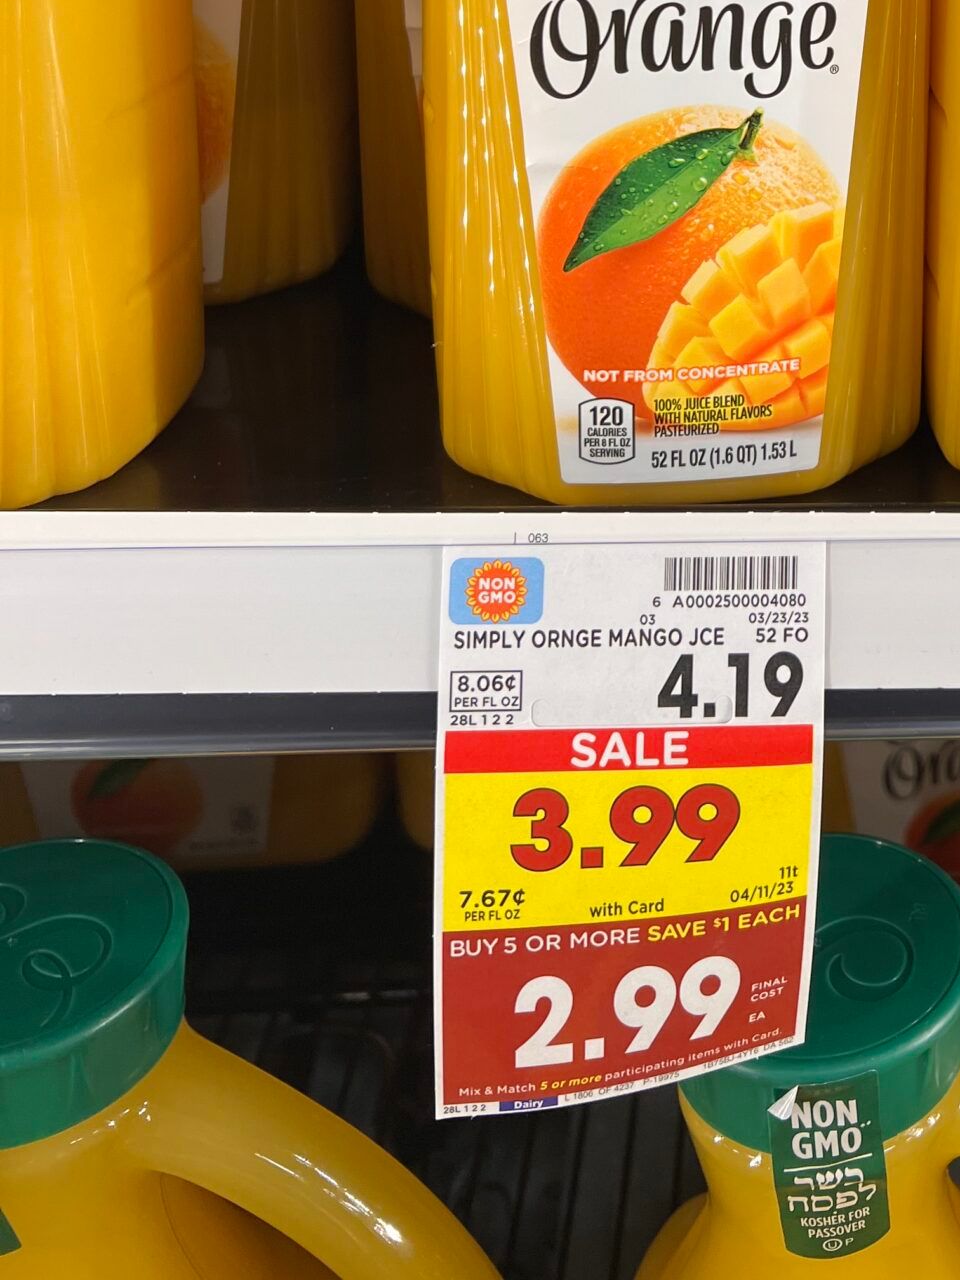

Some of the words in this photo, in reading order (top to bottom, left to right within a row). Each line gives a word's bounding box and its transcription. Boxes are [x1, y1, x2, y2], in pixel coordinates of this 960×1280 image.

[583, 368, 621, 383] NOT
[624, 367, 673, 383] FROM
[677, 358, 800, 381] CONCENTRATE
[653, 398, 682, 412] 100%
[684, 396, 711, 411] JUICE
[713, 394, 745, 408] BLEND
[589, 406, 624, 426] 120
[654, 412, 682, 425] WITH
[683, 408, 729, 424] NATURAL
[730, 404, 773, 420] FLAVORS
[587, 427, 628, 437] CALORIES
[654, 423, 720, 438] PASTEURIZED
[589, 448, 626, 458] SERVING
[651, 451, 668, 469] 52
[670, 450, 686, 468] FL
[689, 448, 707, 466] OZ
[710, 446, 734, 469] (1.6
[736, 444, 758, 466] QT)
[761, 442, 787, 461] 1.53
[789, 440, 798, 458] L
[528, 532, 549, 543] 063
[478, 577, 516, 590] NON
[477, 591, 517, 605] GMO
[672, 593, 807, 609] A0002500004080
[748, 612, 809, 624] 03/23/23
[454, 630, 524, 649] SIMPLY
[532, 630, 602, 648] ORNGE
[608, 629, 683, 647] MANGO
[689, 628, 724, 646] JCE
[755, 628, 777, 643] 52
[783, 627, 809, 643] FO
[458, 674, 517, 693] 8.06¢
[657, 650, 804, 718] 4.19
[570, 731, 689, 768] SALE
[510, 783, 741, 872] 3.99
[459, 888, 525, 908] 7.67¢
[590, 901, 624, 918] with
[628, 898, 665, 917] Card
[730, 881, 794, 903] 04/11/23
[449, 938, 499, 958] BUY
[504, 936, 517, 954] 5
[525, 934, 561, 952] OR
[570, 927, 641, 949] MORE
[647, 920, 706, 942] SAVE
[713, 916, 730, 933] $1
[738, 904, 801, 929] EACH
[751, 975, 788, 993] FINAL
[750, 987, 783, 1003] COST
[514, 955, 741, 1069] 2.99
[748, 1010, 766, 1024] EA
[458, 1087, 481, 1097] Mix
[484, 1086, 493, 1095] &
[497, 1083, 536, 1094] Match
[540, 1081, 548, 1091] 5
[551, 1081, 567, 1090] or
[568, 1074, 602, 1087] more
[605, 1054, 685, 1082] participating
[688, 1047, 721, 1063] items
[724, 1037, 749, 1052] with
[514, 1099, 544, 1110] Dairy
[790, 1100, 858, 1129] NON
[792, 1126, 862, 1160] GMO
[800, 1213, 845, 1228] KOSHER
[848, 1206, 870, 1222] FOR
[808, 1220, 866, 1239] PASSOVER
